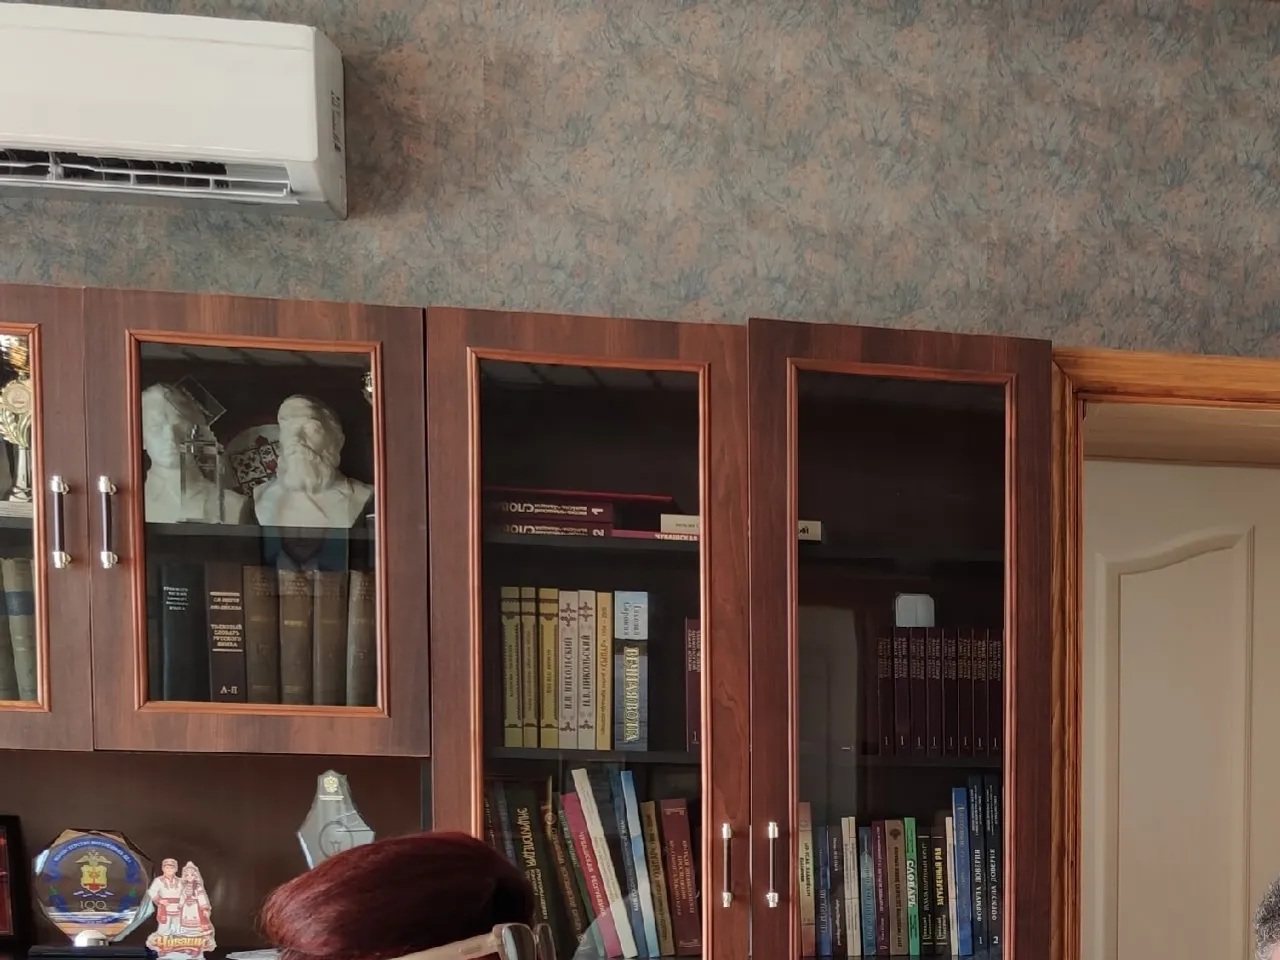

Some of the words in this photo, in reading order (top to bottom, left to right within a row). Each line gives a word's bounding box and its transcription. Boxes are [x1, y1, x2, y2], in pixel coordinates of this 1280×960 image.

[580, 634, 591, 690] НИКОЛЬСКИЙ
[516, 807, 538, 868] ЭНЦИКЛОПЕДИЯ
[906, 860, 916, 907] СЛОВАРЬ
[153, 934, 209, 950] Чуваши
